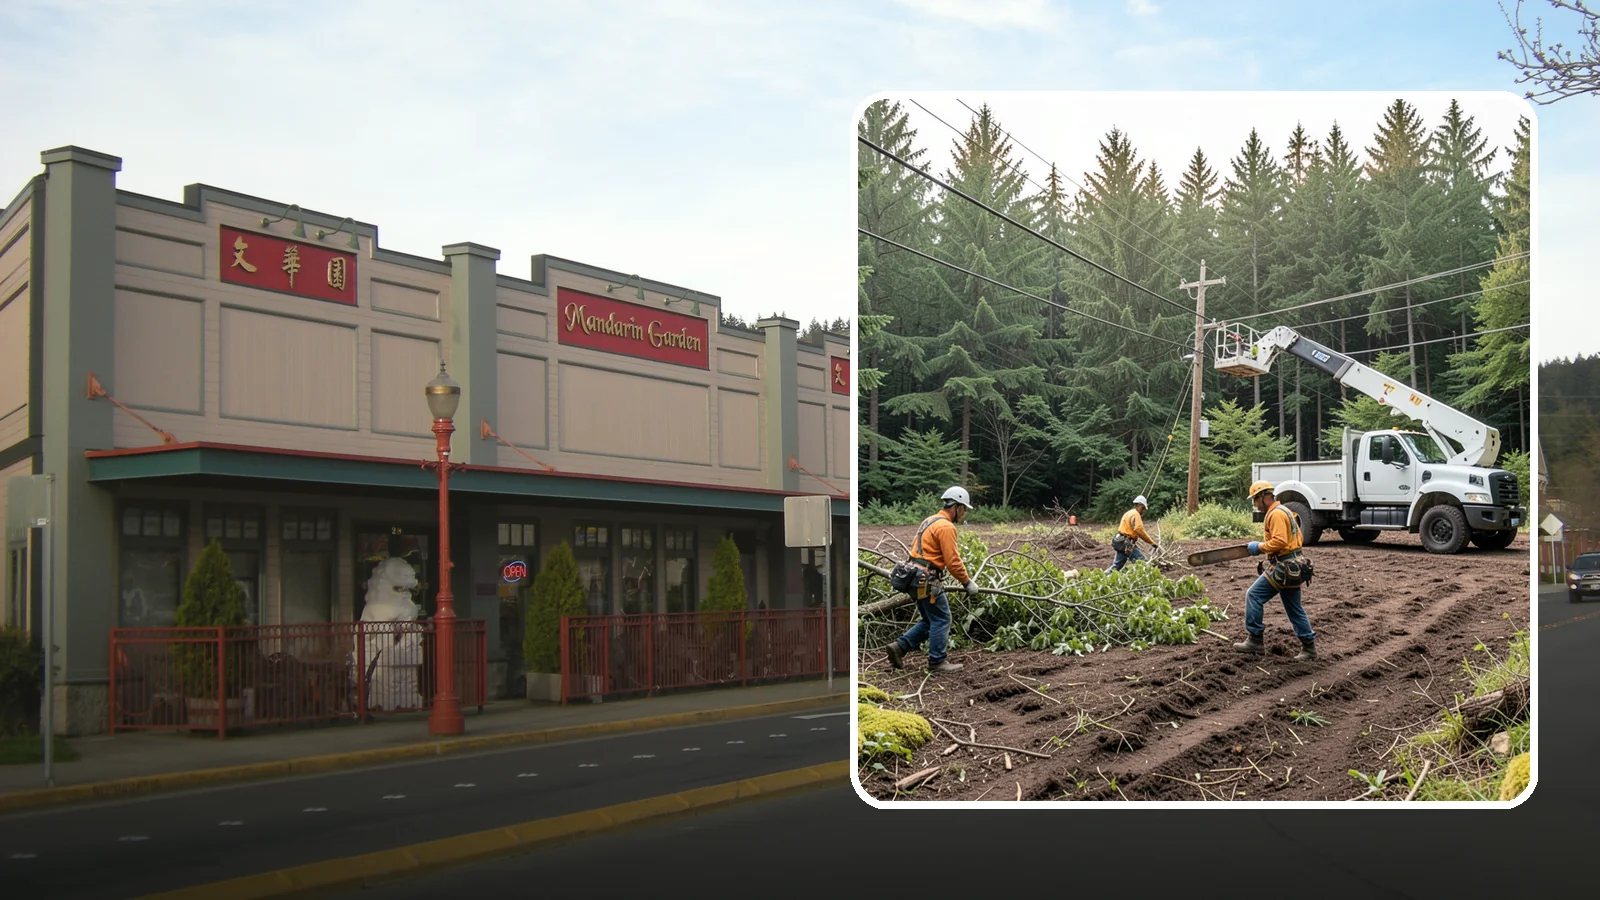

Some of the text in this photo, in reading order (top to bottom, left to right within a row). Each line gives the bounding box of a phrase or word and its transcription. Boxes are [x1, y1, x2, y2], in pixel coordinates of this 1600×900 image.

[230, 235, 346, 291] 文華園
[564, 302, 701, 352] Mandarin Garden
[503, 565, 527, 578] OPEN
